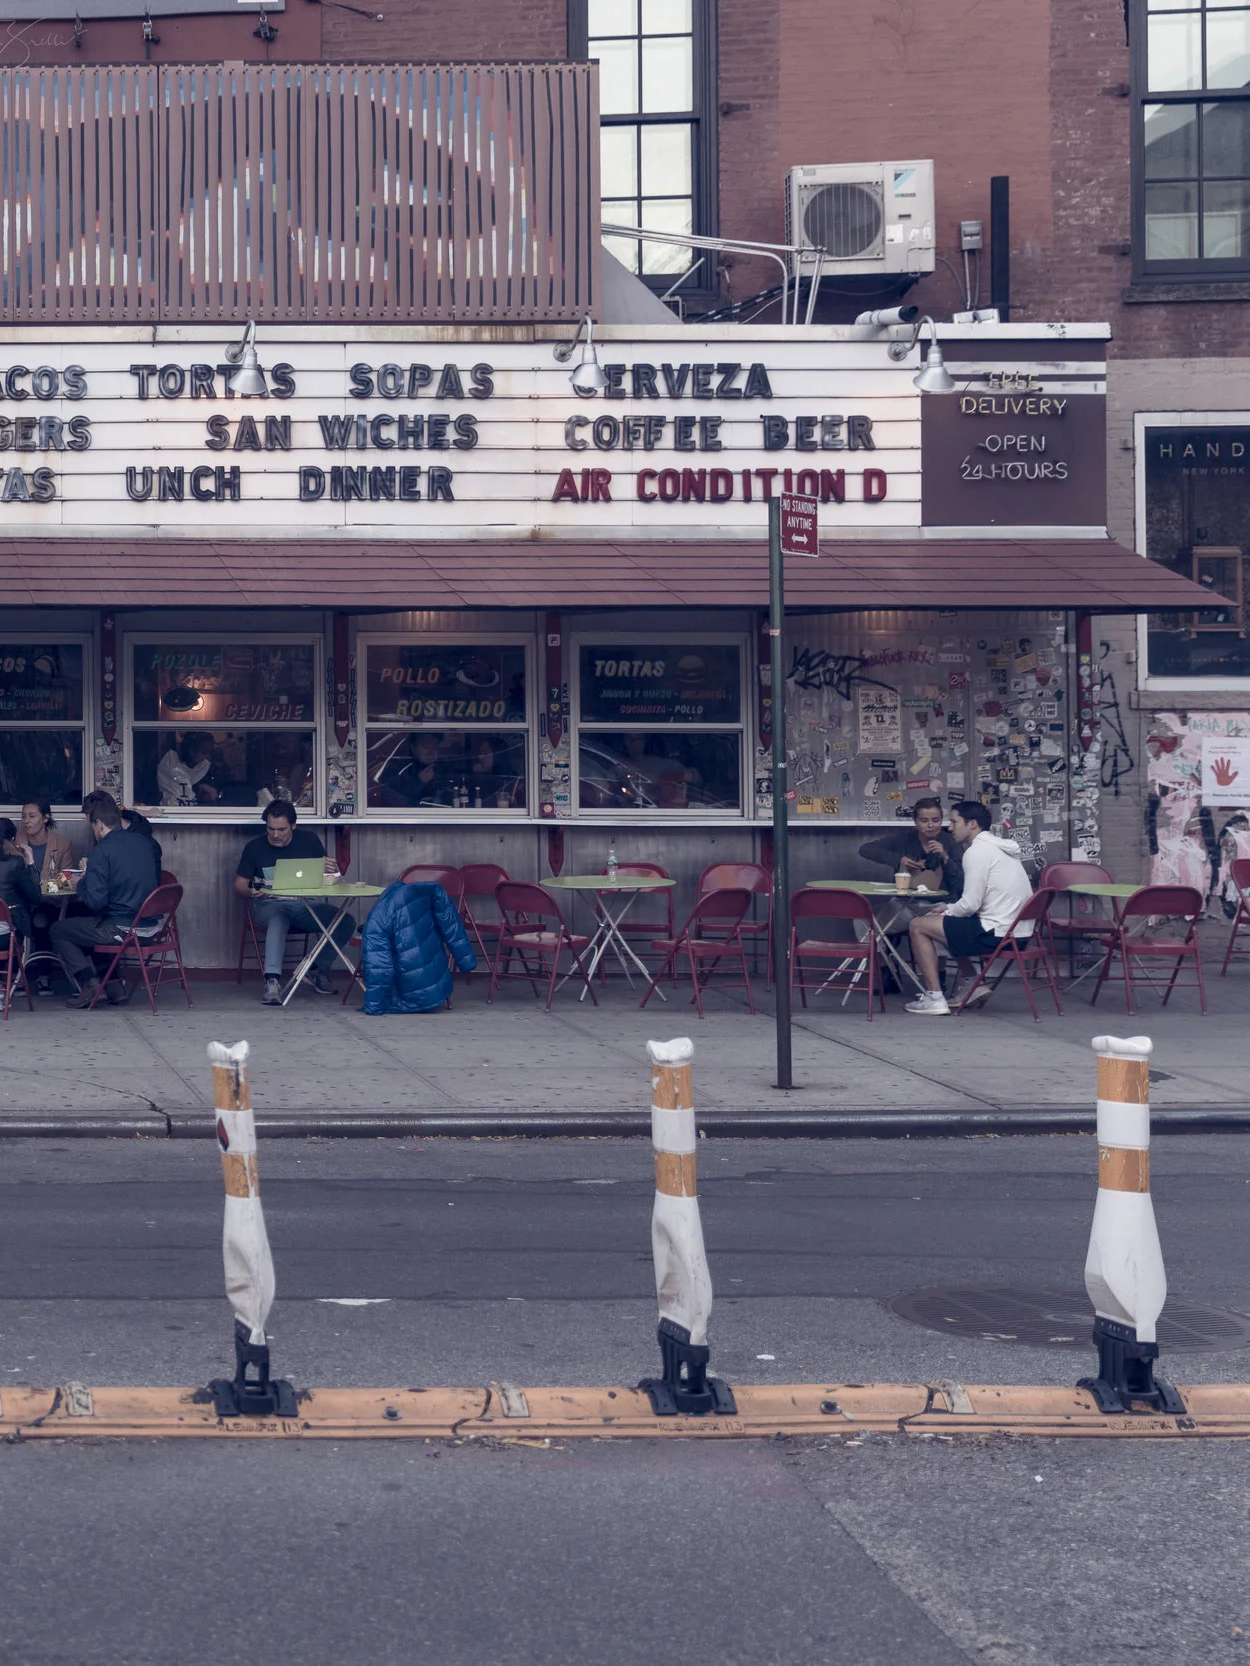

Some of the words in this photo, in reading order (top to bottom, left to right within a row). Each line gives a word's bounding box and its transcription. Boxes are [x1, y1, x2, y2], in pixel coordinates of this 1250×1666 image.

[129, 363, 296, 400] TORTS
[348, 363, 494, 400] SOPAS
[986, 372, 1040, 391] FREE
[961, 396, 1067, 416] DELIVERY
[205, 414, 292, 451] SAN
[317, 413, 480, 451] WICHES
[563, 414, 725, 451] COFFEE
[763, 414, 876, 451] BEER
[984, 434, 1046, 453] OPEN
[1159, 442, 1245, 458] HAND
[961, 462, 983, 481] 24
[992, 462, 1068, 481] HOURS
[1182, 467, 1208, 476] NEW
[1212, 467, 1246, 476] YORK
[125, 465, 241, 502] UNCH
[298, 465, 455, 502] DINNER
[552, 467, 612, 503] AIR
[782, 498, 791, 511] NO
[792, 499, 816, 515] STANDING
[786, 515, 813, 531] ANYTIME
[151, 652, 222, 670] POZOLE
[594, 660, 667, 678] TORTAS
[380, 667, 440, 684] POLLO
[225, 703, 304, 720] CEVICHE
[396, 699, 506, 718] ROSTIZADO
[674, 705, 704, 713] POLLO
